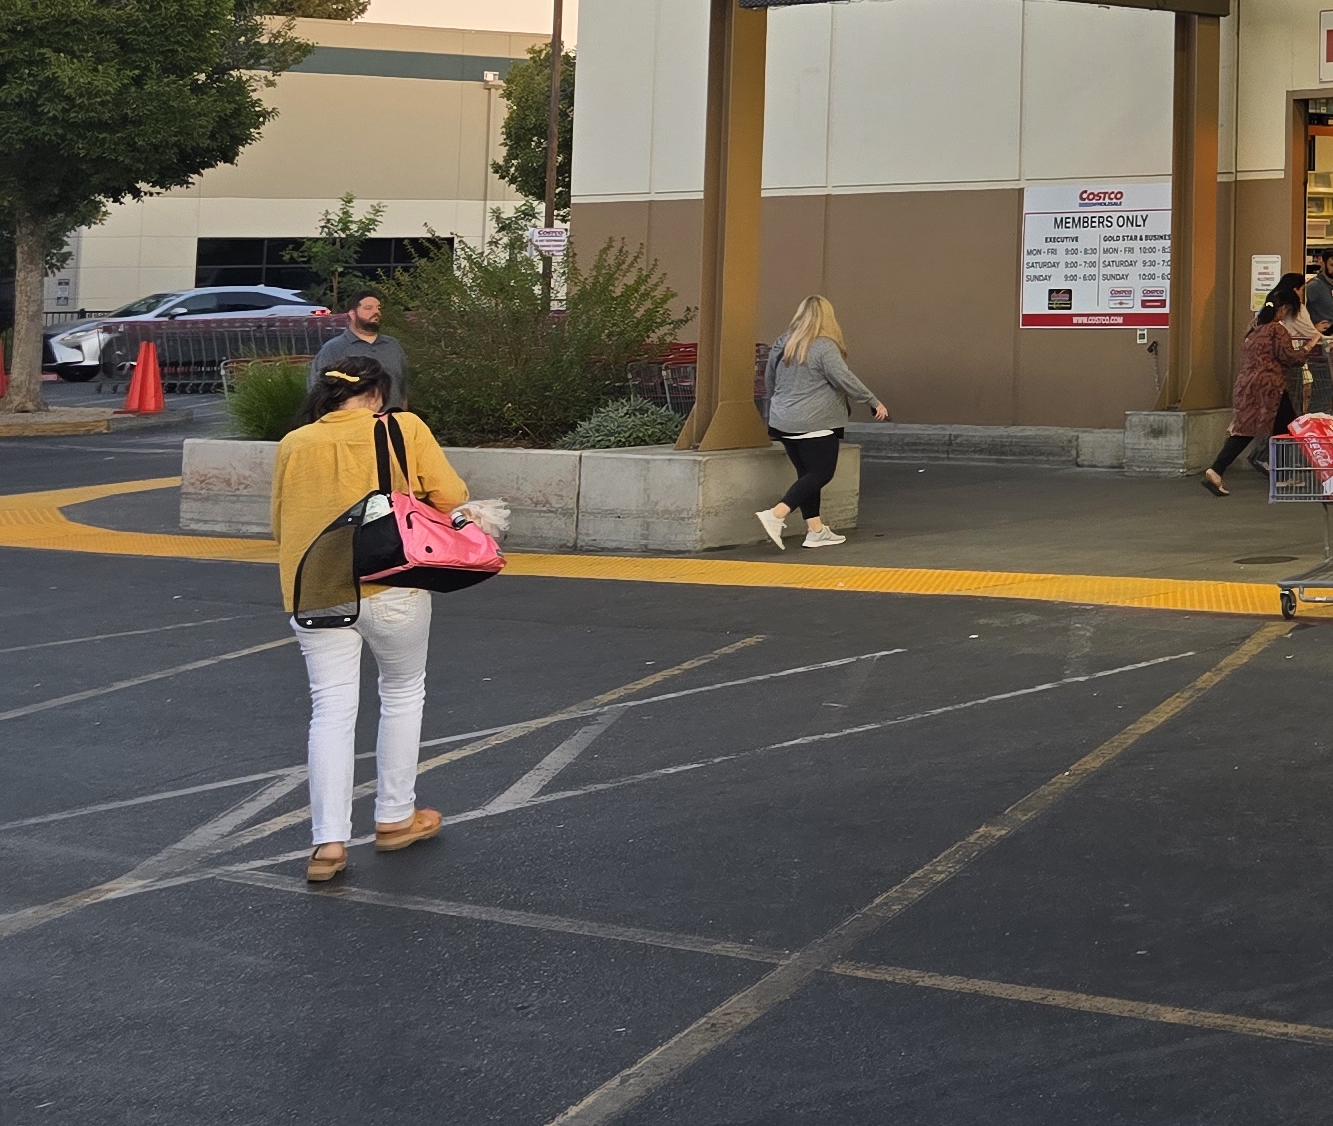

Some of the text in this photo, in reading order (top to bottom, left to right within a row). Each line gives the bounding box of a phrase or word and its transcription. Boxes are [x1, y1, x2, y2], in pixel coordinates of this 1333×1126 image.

[1079, 190, 1124, 201] COSTCO
[1054, 215, 1148, 229] MEMBERS ONLY
[1139, 246, 1157, 254] 10:00
[1026, 261, 1060, 269] SATURDAY
[1102, 260, 1138, 268] SATURDAY
